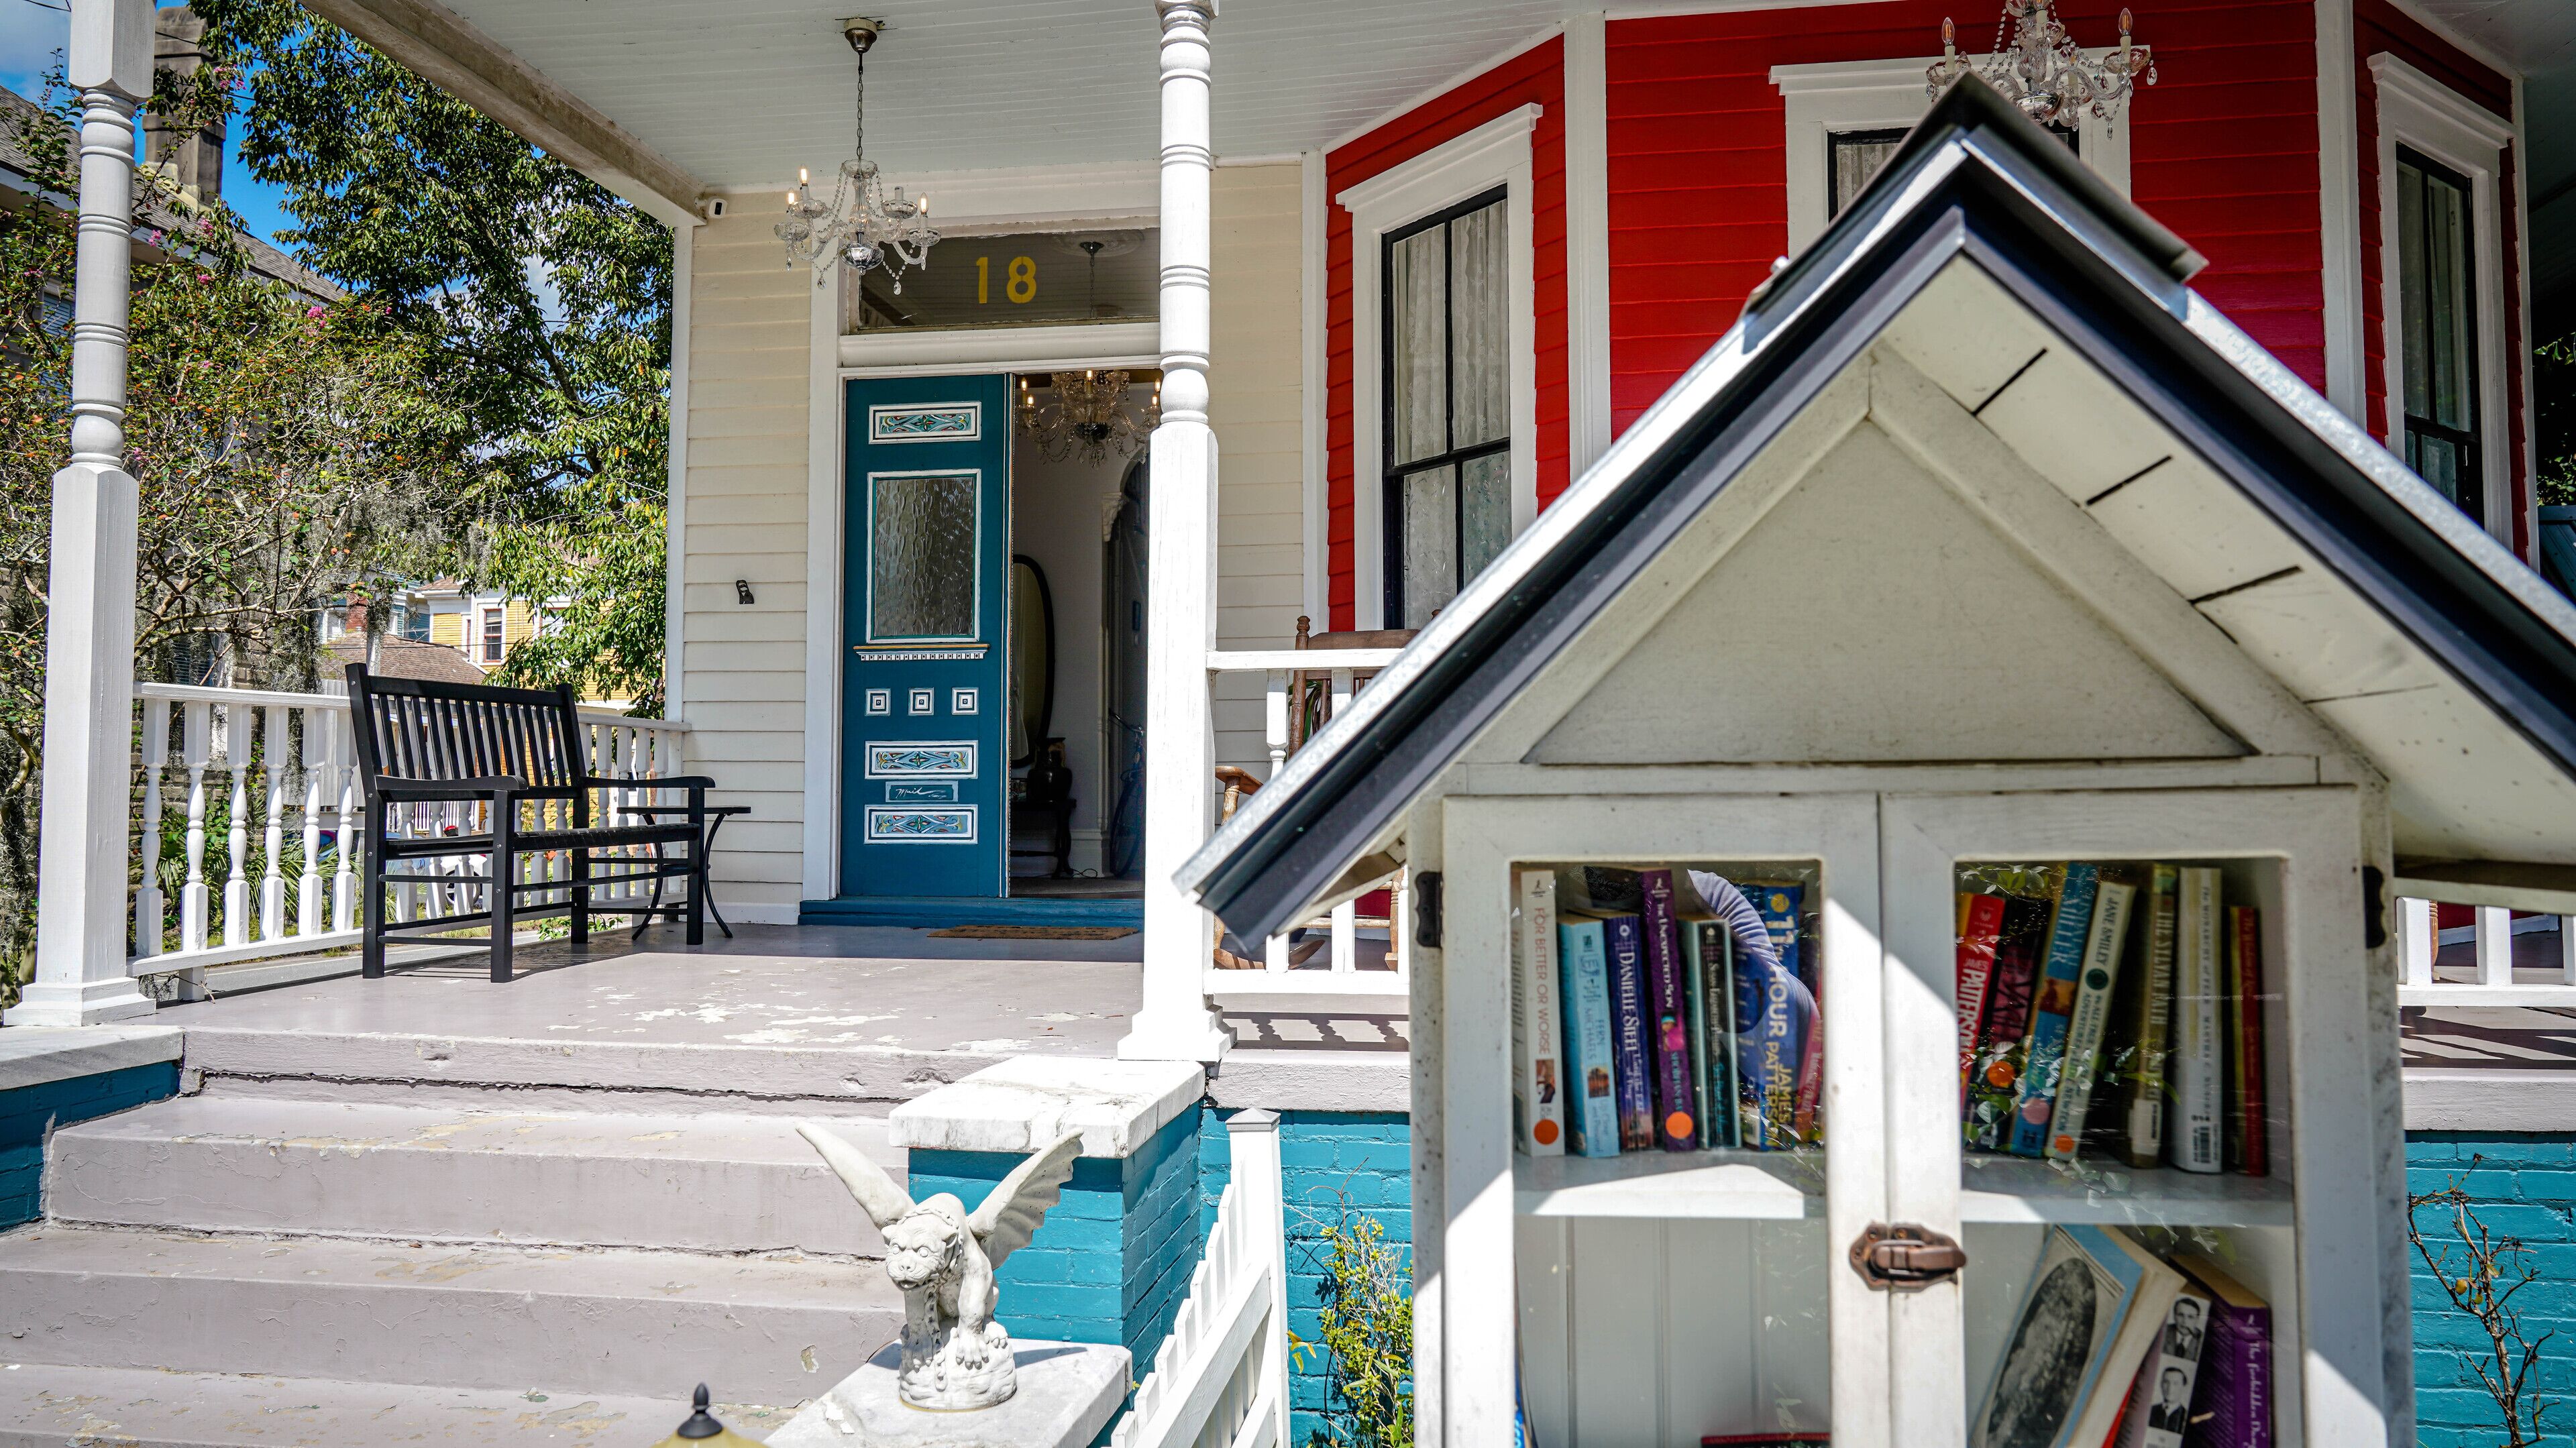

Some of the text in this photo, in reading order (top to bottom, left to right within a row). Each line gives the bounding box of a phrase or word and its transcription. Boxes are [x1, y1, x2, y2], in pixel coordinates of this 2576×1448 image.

[975, 256, 1038, 304] 18
[896, 787, 941, 799] Mail
[2048, 897, 2080, 964] MILLER
[2095, 897, 2120, 966] JANE SMILEY
[1534, 907, 1550, 1054] FOR BETTER OR WORSE
[1619, 952, 1635, 1012] DANIELLE
[1963, 958, 1990, 972] JAMES
[2150, 911, 2174, 1025] THE SYLVAN PATH
[1595, 1019, 1605, 1046] FERN
[1623, 1015, 1640, 1051] STEEL
[1778, 1064, 1792, 1123] JAMES
[2248, 1341, 2261, 1359] The
[2246, 1362, 2262, 1418] Forbidden
